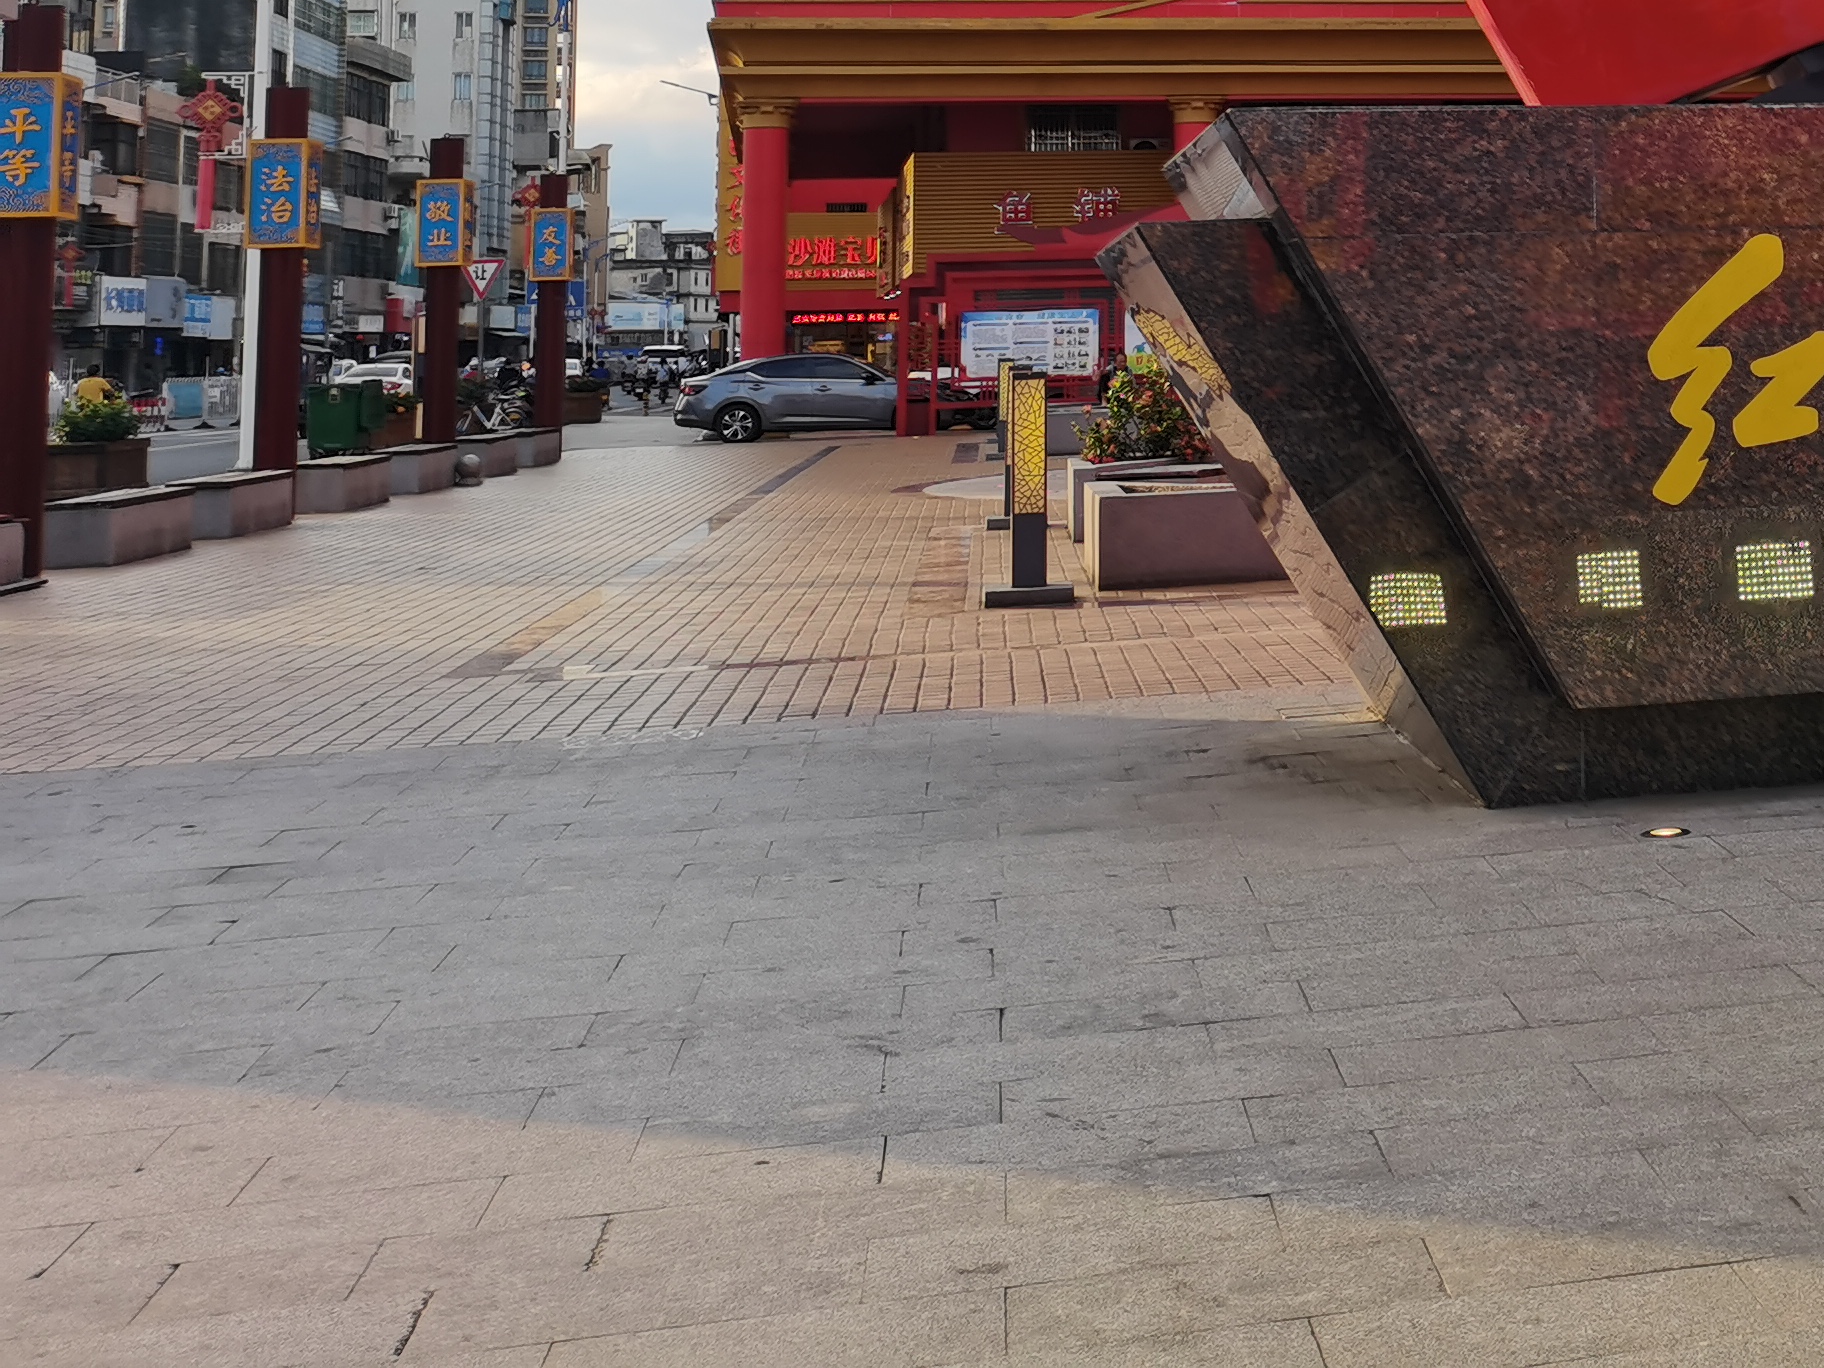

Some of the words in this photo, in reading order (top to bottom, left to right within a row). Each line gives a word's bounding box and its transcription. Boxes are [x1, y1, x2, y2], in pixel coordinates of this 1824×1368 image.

[0, 107, 42, 187] 平等
[260, 165, 295, 224] 法治
[426, 200, 454, 246] 敬业
[539, 226, 562, 266] 友善
[473, 264, 487, 281] 让
